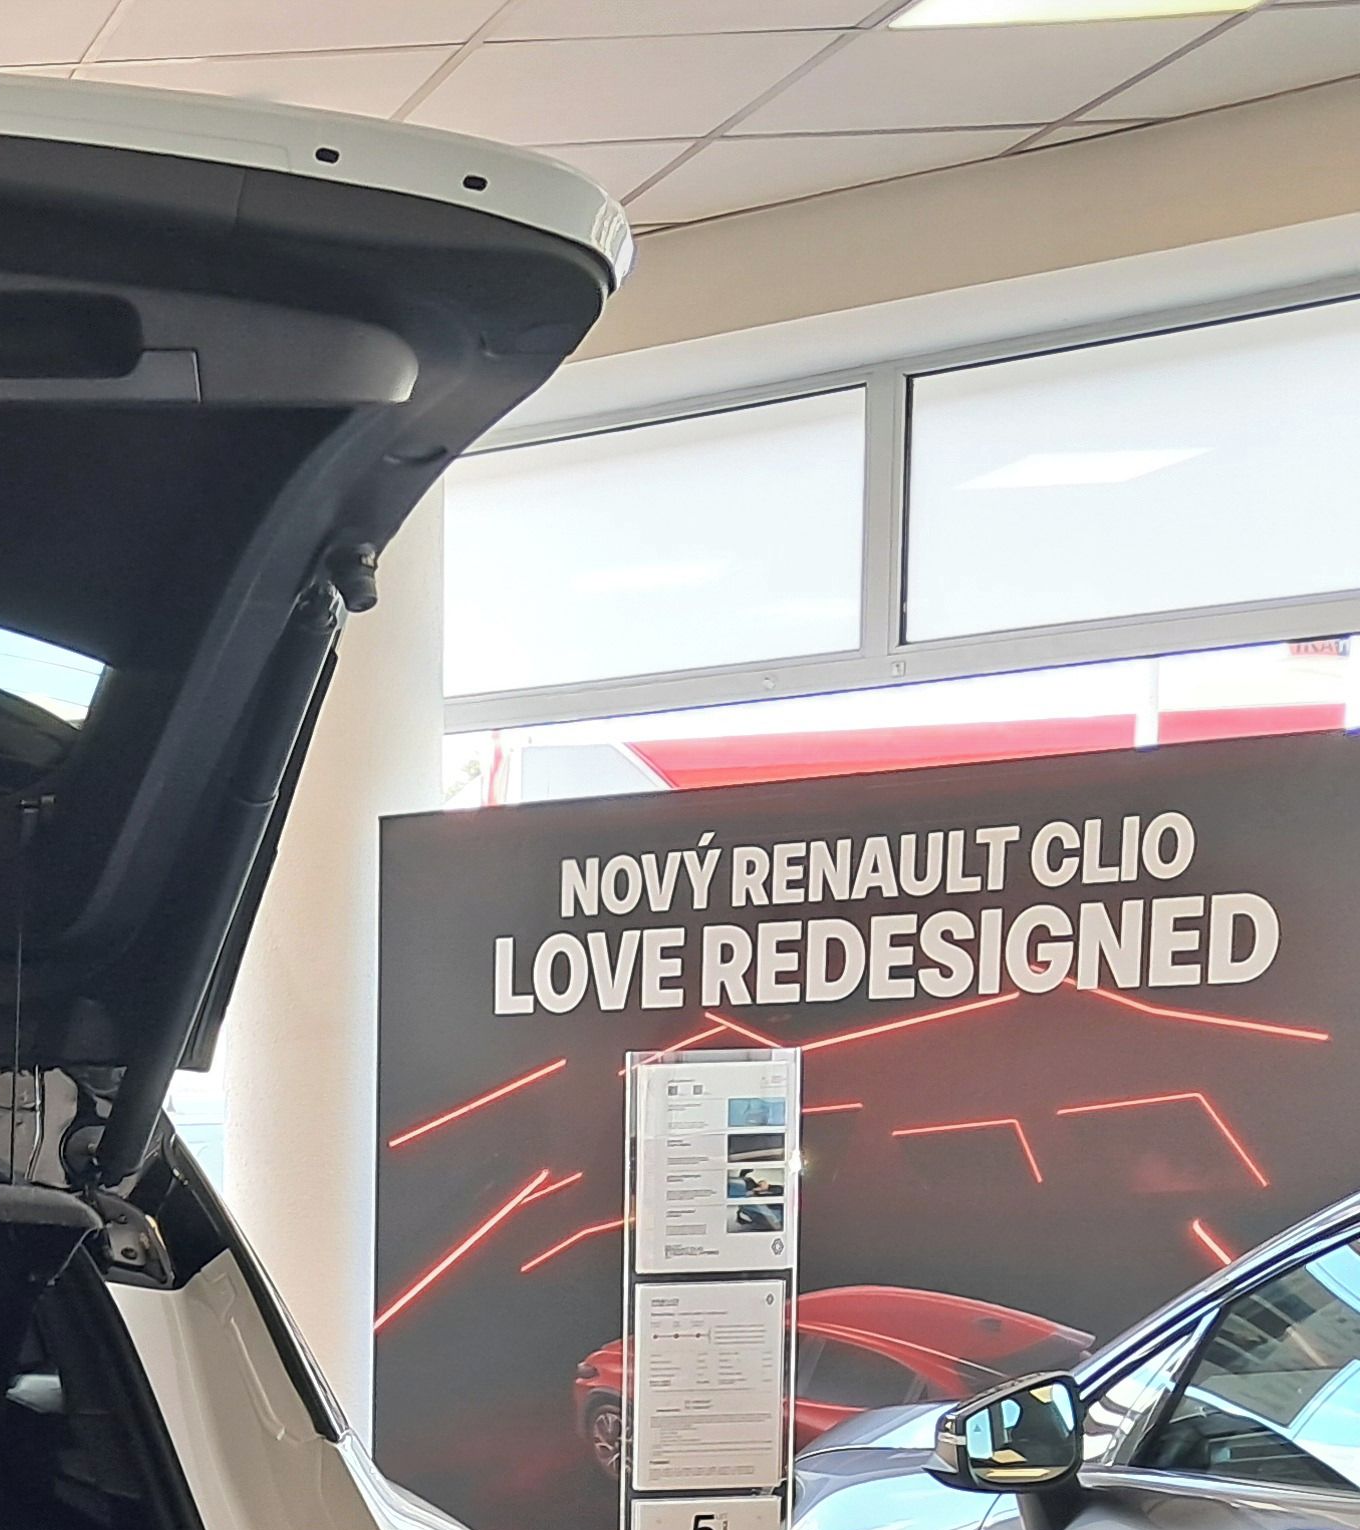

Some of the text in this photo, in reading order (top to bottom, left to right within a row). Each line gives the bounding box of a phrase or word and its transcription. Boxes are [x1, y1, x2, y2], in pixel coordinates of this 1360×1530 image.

[561, 811, 1196, 919] NOVÝ RENAULT CLIO
[493, 892, 1281, 1015] LOVE REDESIGNED
